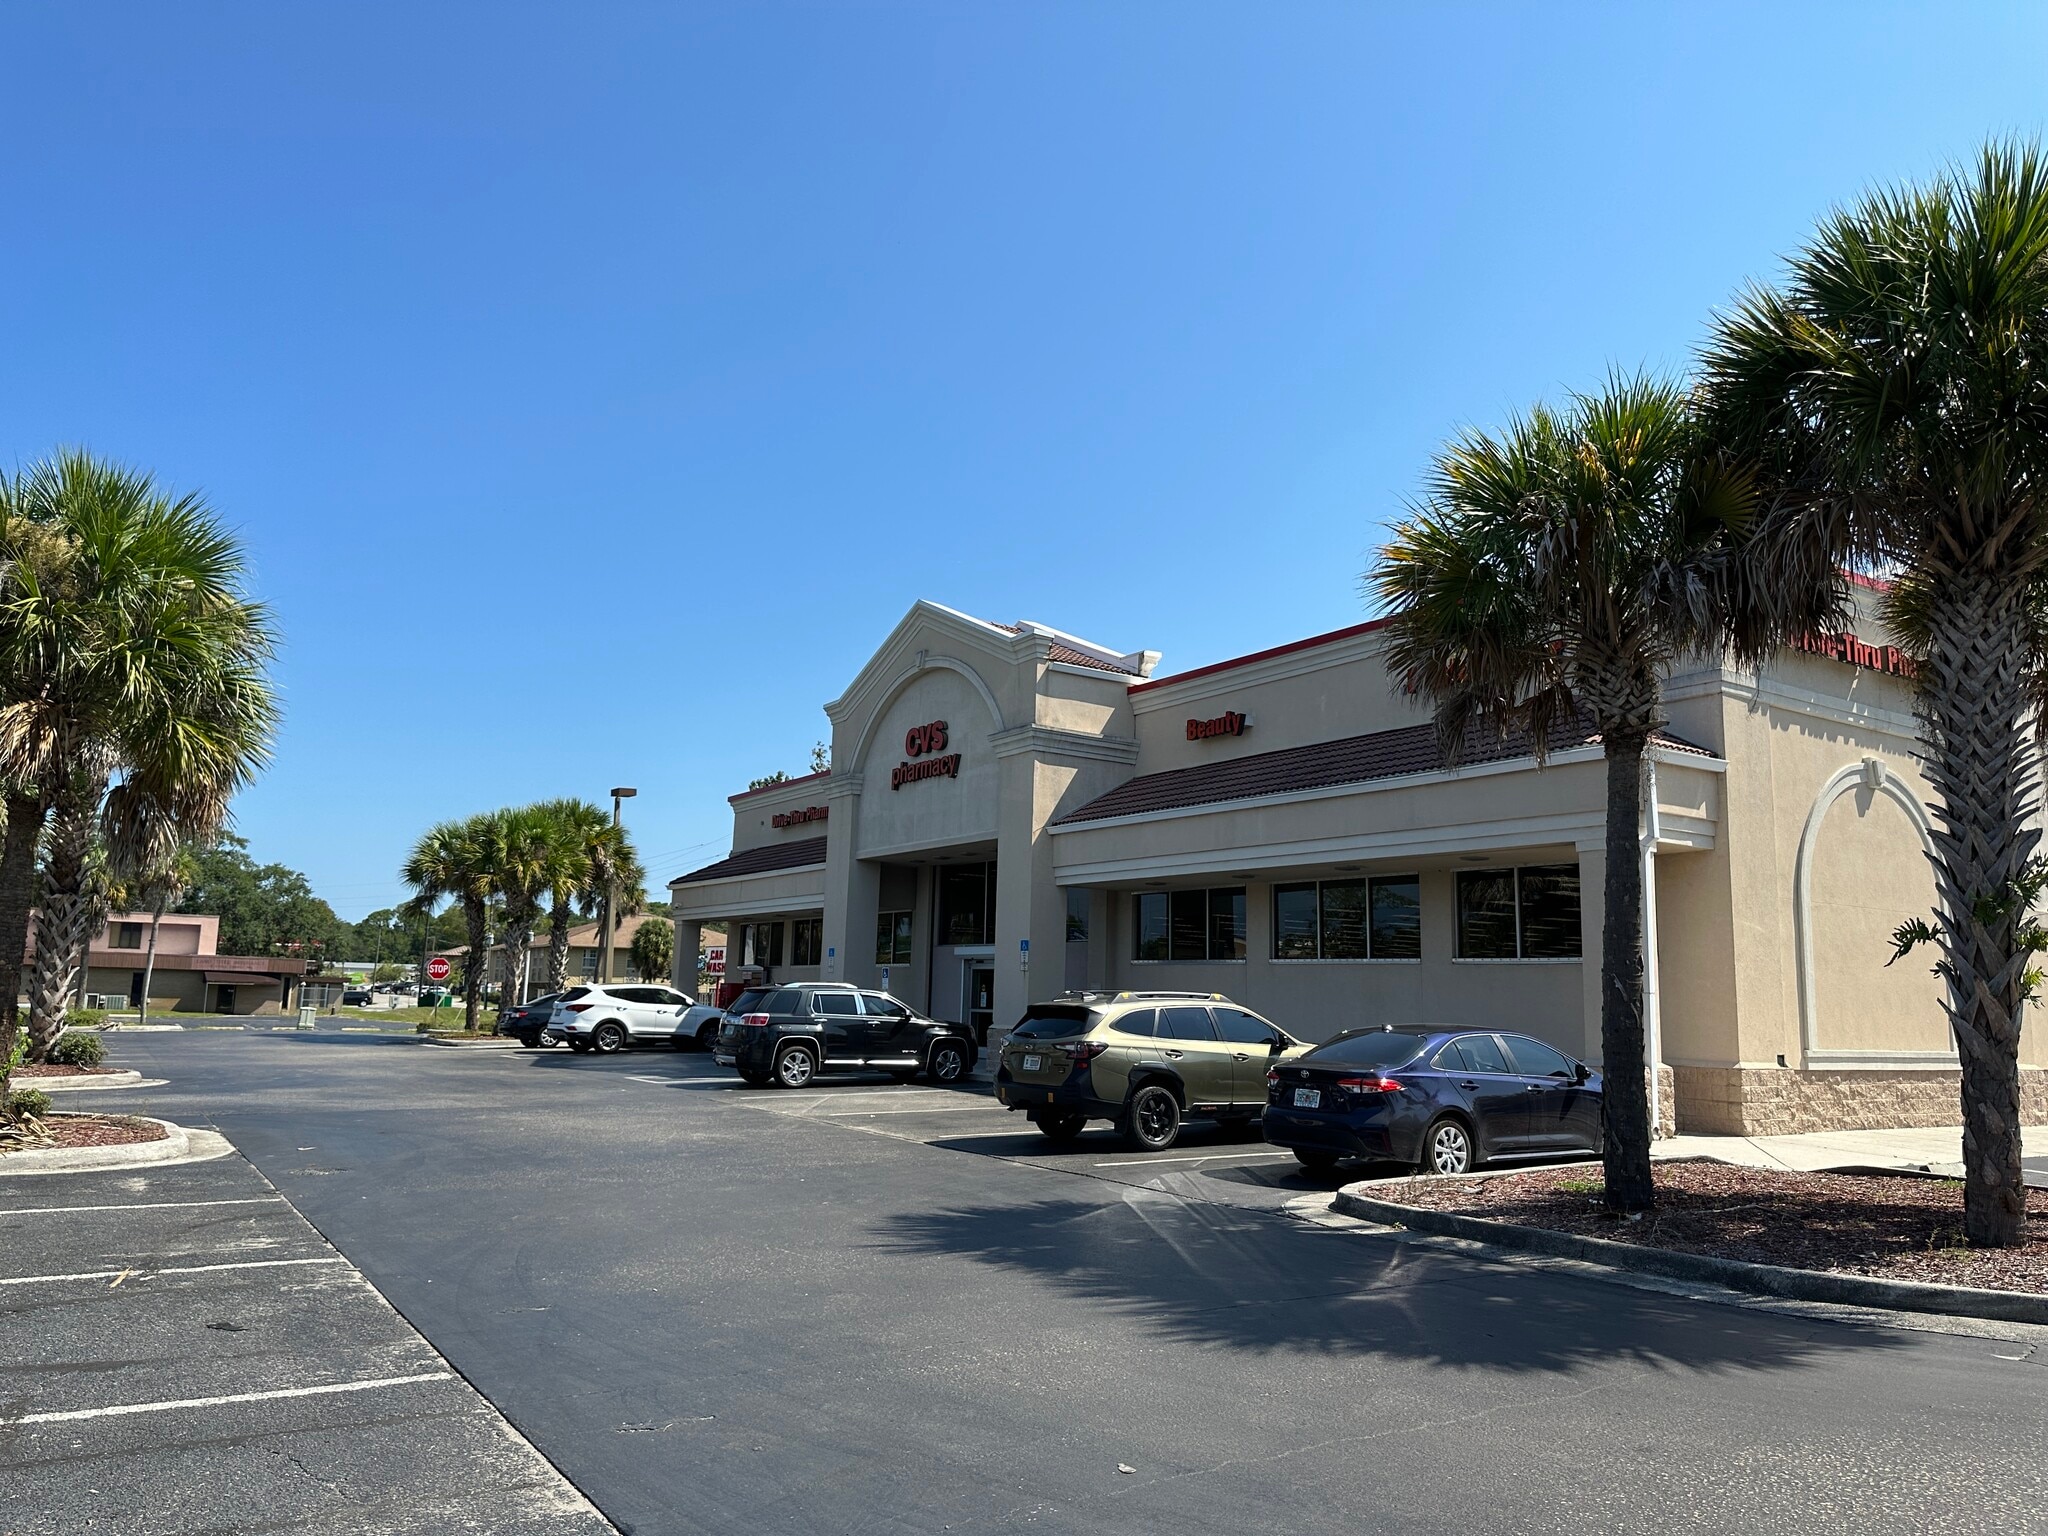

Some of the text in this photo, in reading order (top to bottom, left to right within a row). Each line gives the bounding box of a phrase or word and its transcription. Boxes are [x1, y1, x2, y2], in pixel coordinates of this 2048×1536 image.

[1187, 711, 1246, 741] Beauty
[905, 720, 948, 757] CVS
[891, 753, 961, 791] pharmacy
[806, 806, 829, 822] Pharm
[711, 950, 724, 961] CAR
[429, 964, 449, 974] STOP
[707, 962, 726, 973] WASH
